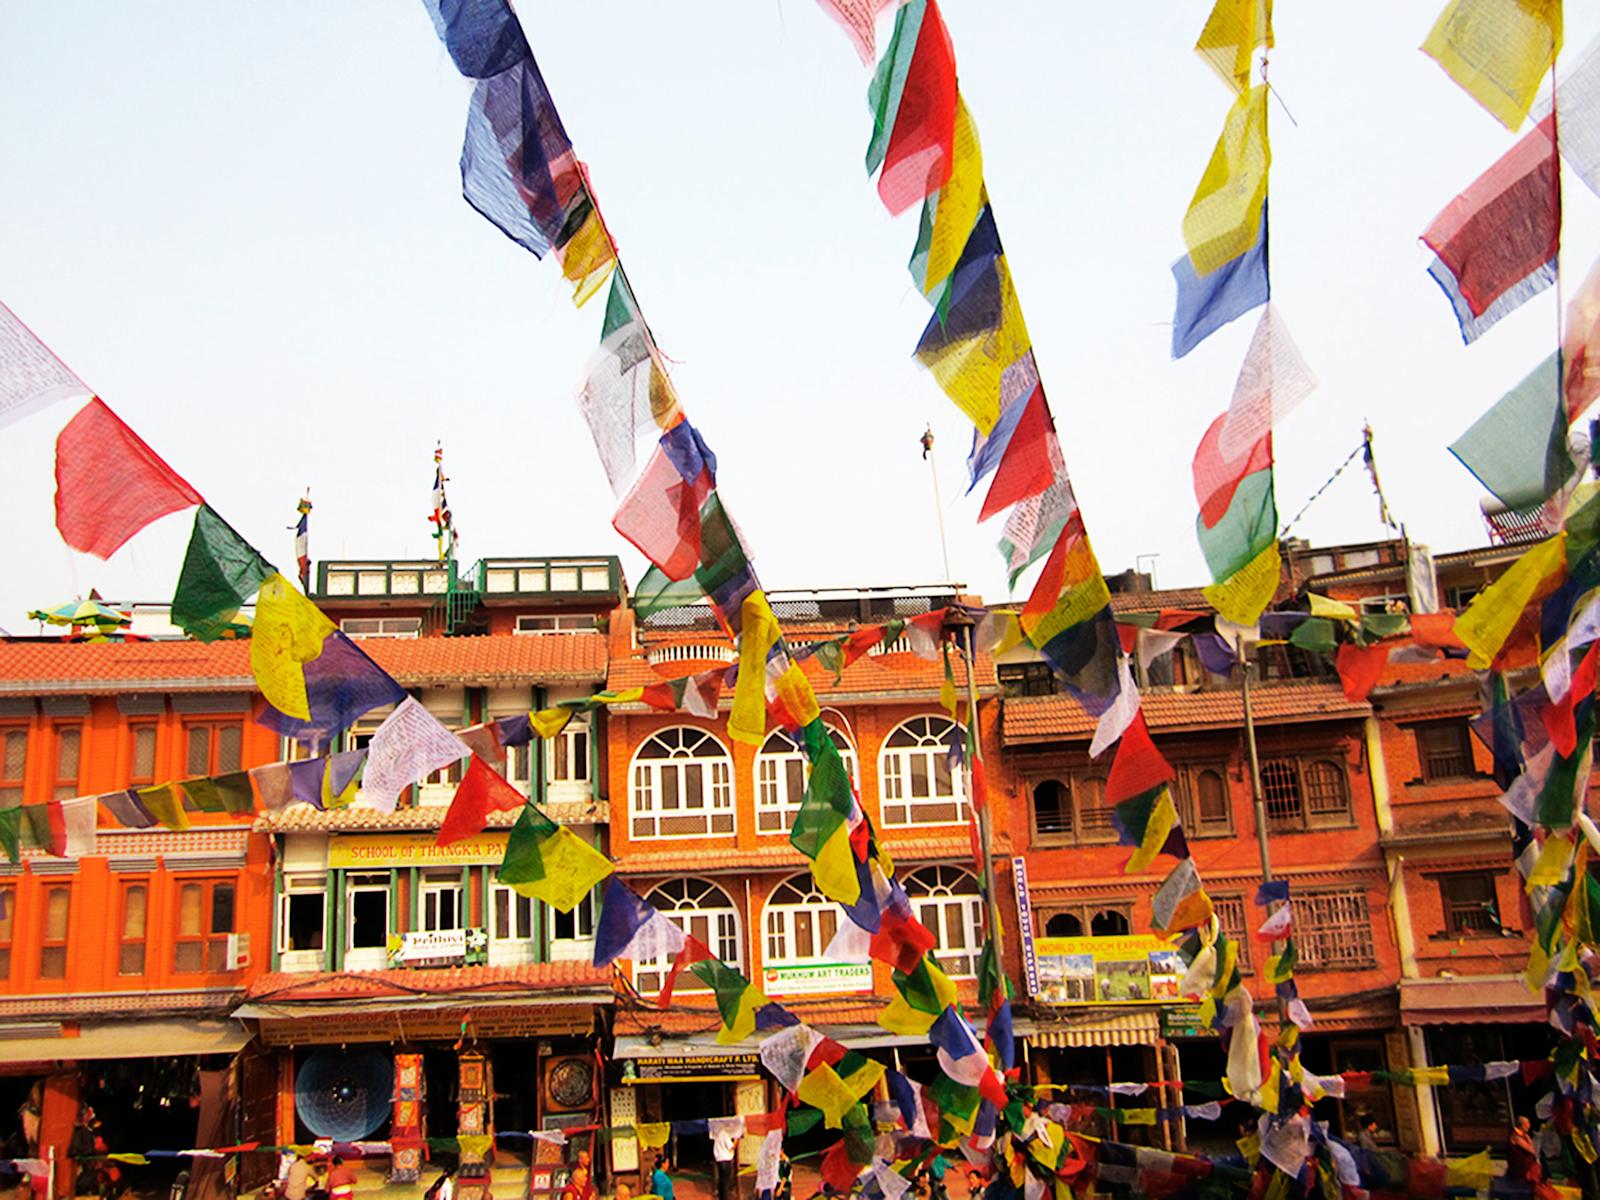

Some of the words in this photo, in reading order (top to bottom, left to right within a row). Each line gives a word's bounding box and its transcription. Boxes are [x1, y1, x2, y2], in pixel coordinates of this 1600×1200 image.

[351, 846, 398, 859] SCHOOL
[402, 845, 416, 858] OF
[421, 844, 481, 857] THANGKA
[1039, 943, 1076, 953] WORLD
[1080, 942, 1114, 952] TOUCH
[1116, 940, 1163, 951] EXPRESS
[817, 969, 832, 978] ART
[834, 967, 870, 977] TRADERS
[311, 1016, 361, 1025] SCHOOL
[366, 1014, 378, 1023] OF
[685, 1056, 733, 1065] HANDICRAFT
[743, 1054, 759, 1063] LTD.
